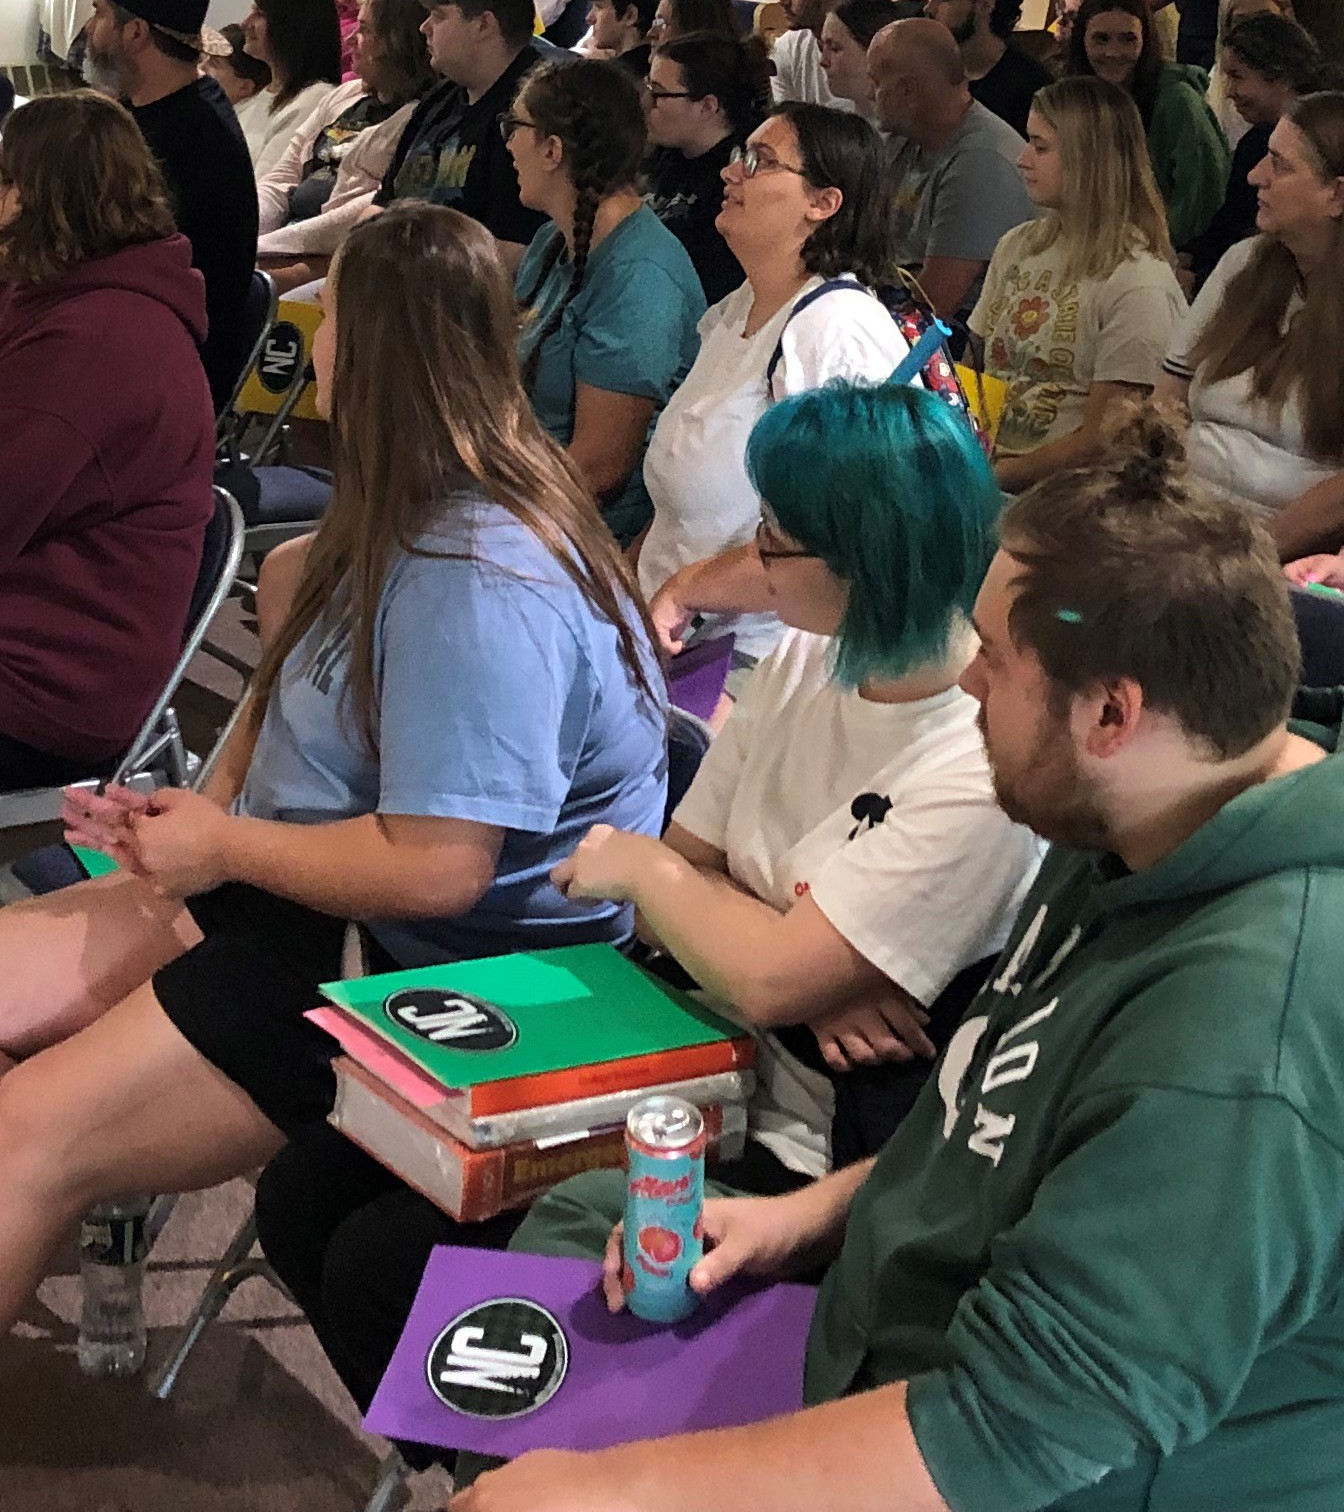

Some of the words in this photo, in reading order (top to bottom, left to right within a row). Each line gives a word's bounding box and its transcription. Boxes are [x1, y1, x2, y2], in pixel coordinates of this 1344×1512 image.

[261, 338, 298, 376] NC
[397, 998, 495, 1038] NC
[440, 1326, 548, 1395] NC
